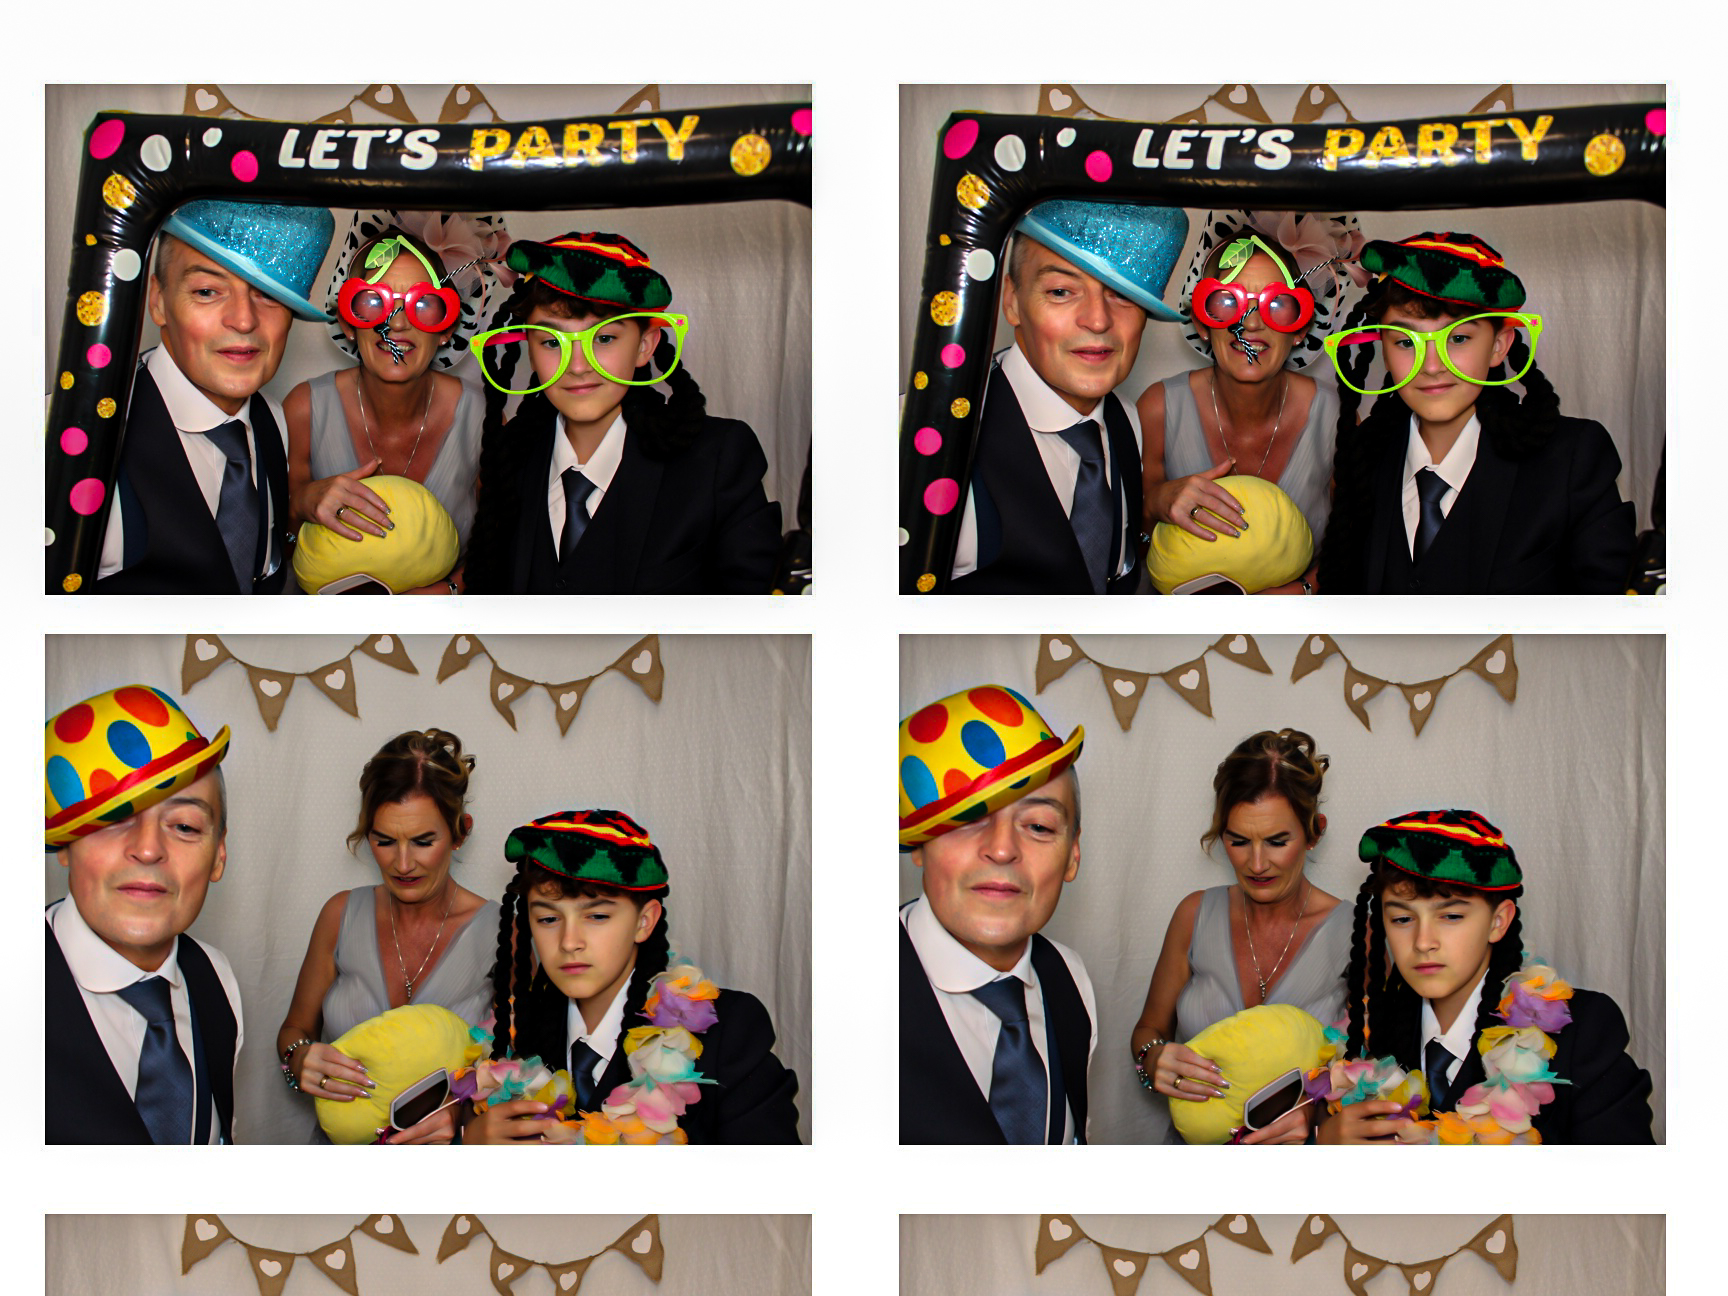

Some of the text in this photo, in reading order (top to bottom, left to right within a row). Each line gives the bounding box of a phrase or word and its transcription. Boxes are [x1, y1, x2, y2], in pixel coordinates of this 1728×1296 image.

[278, 114, 700, 172] LET'S PARTY
[1132, 114, 1554, 172] LET'S PARTY
